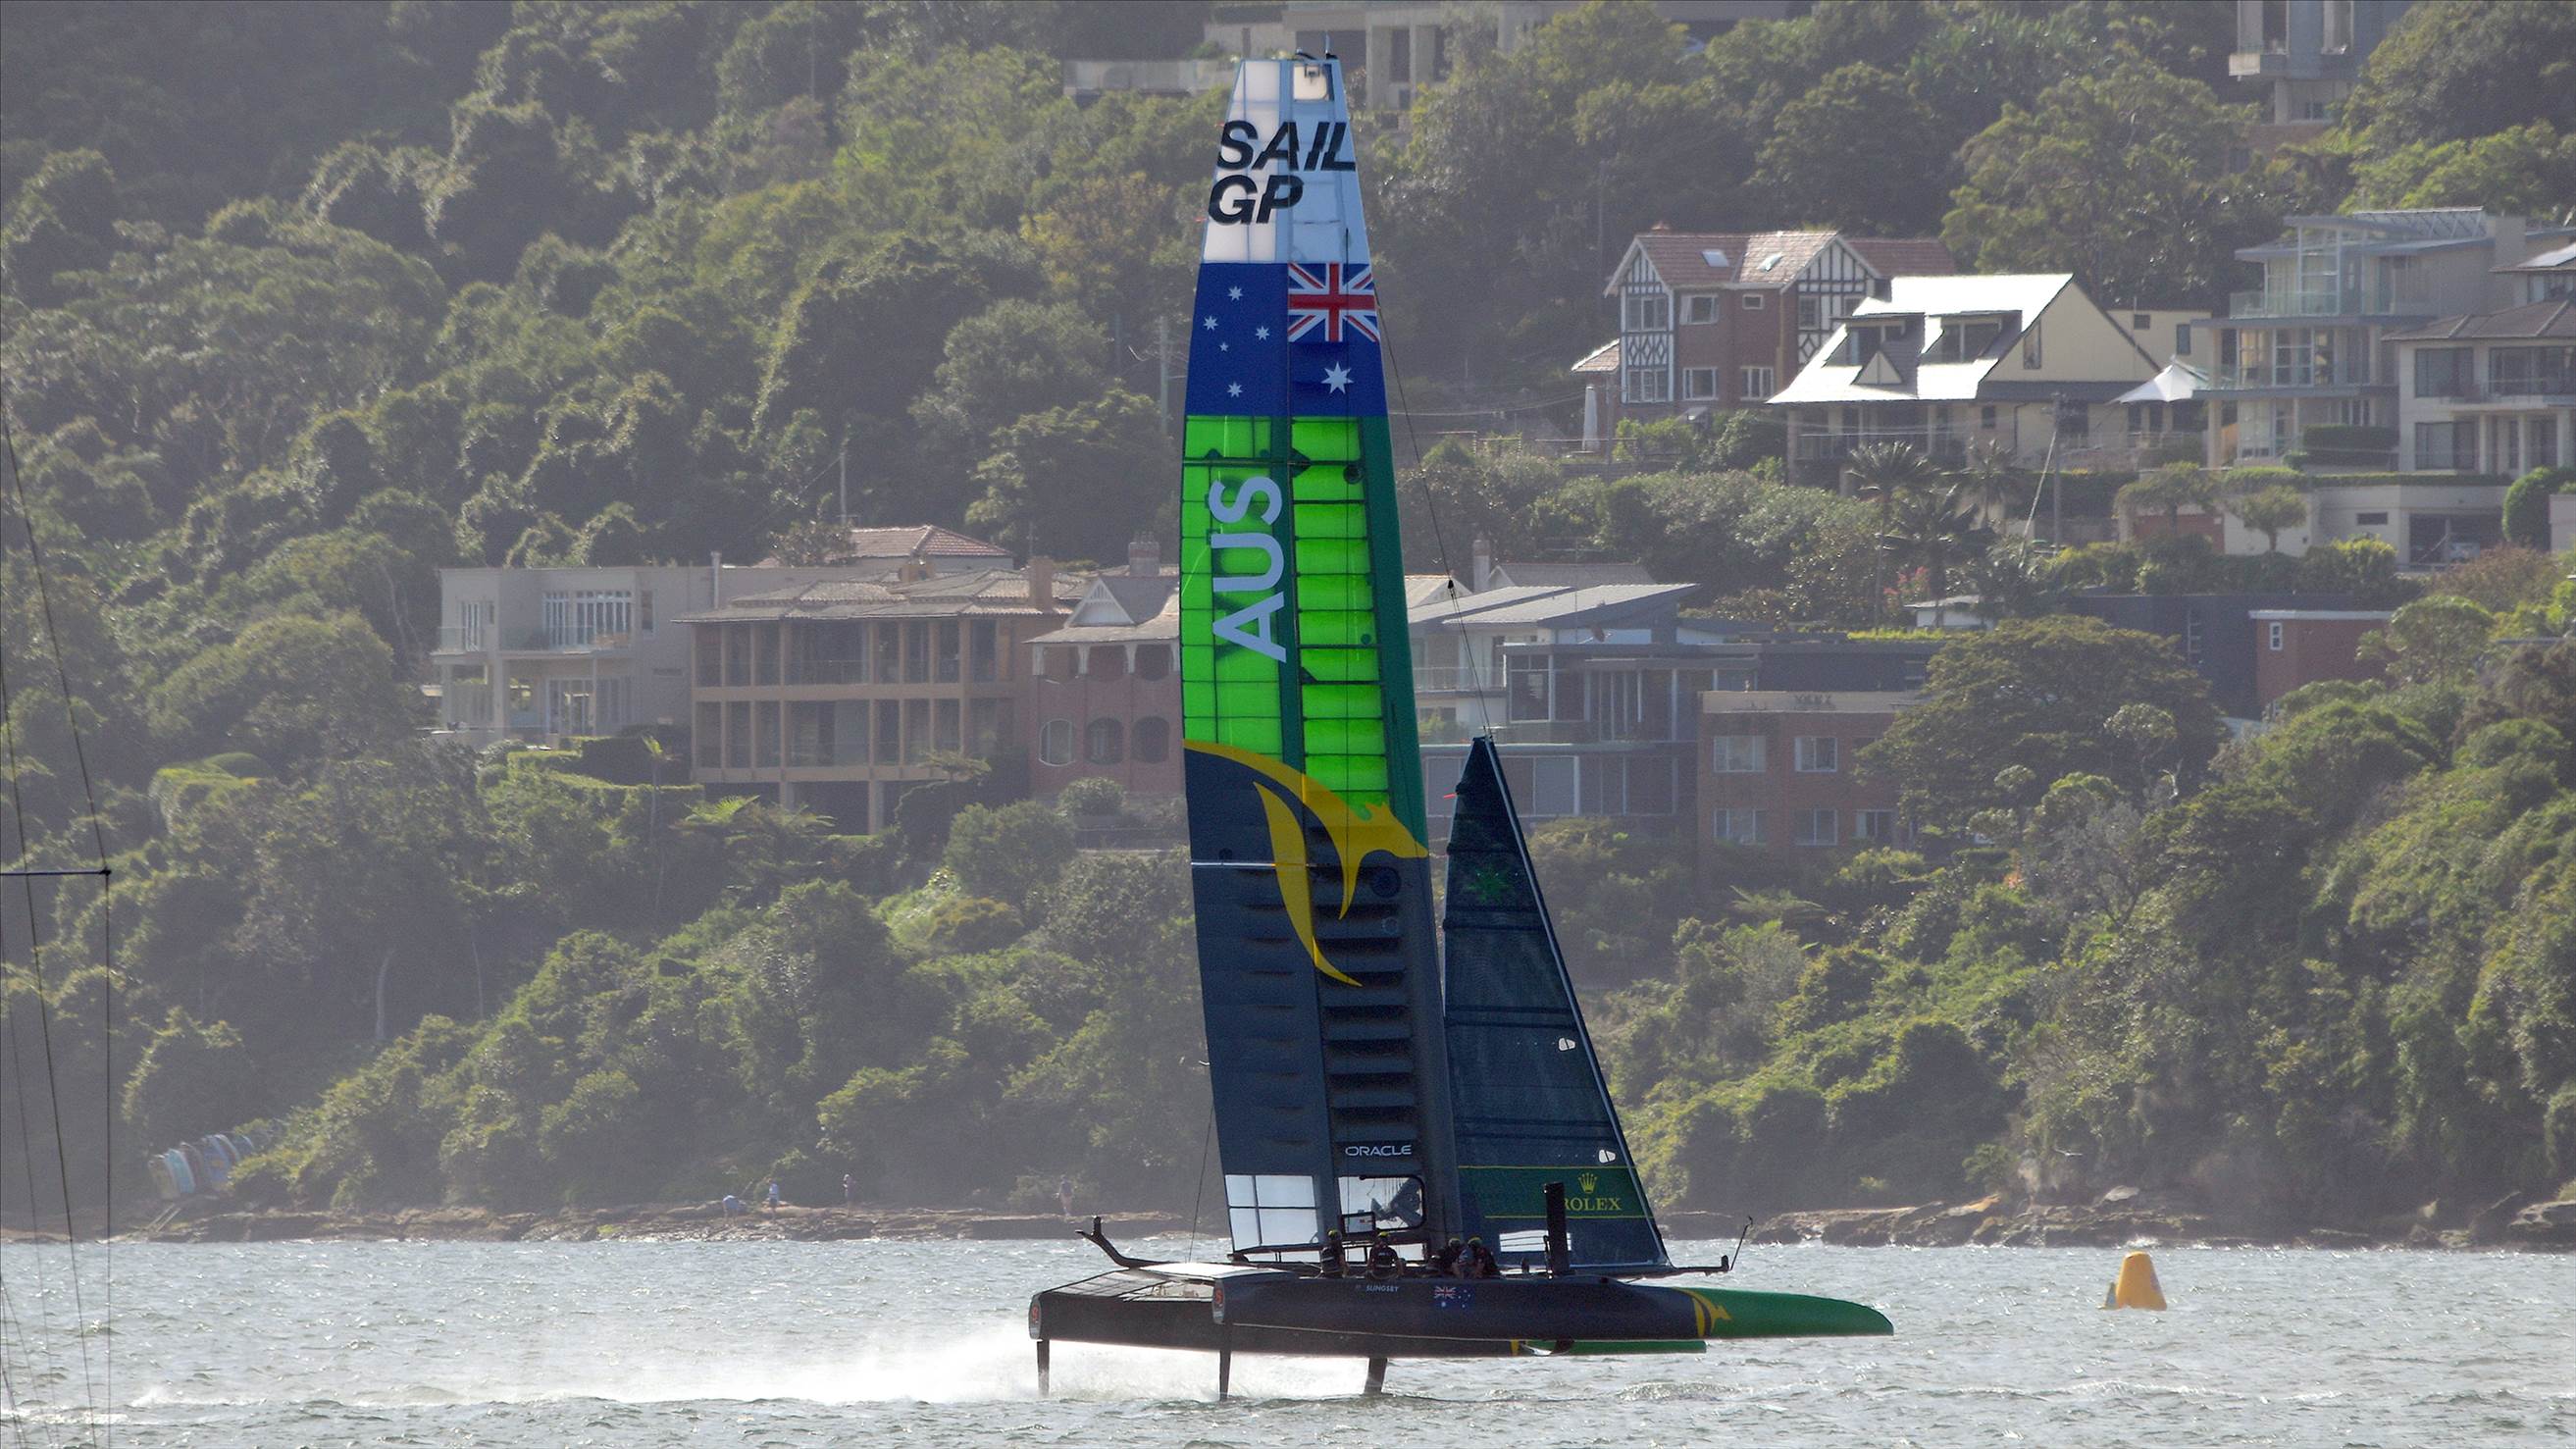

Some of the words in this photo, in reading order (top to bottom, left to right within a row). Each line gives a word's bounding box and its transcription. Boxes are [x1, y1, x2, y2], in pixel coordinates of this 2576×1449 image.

[1216, 120, 1356, 172] SAIL
[1209, 175, 1304, 225] GP
[1208, 476, 1287, 663] AUS
[1345, 1145, 1412, 1156] ORACLE
